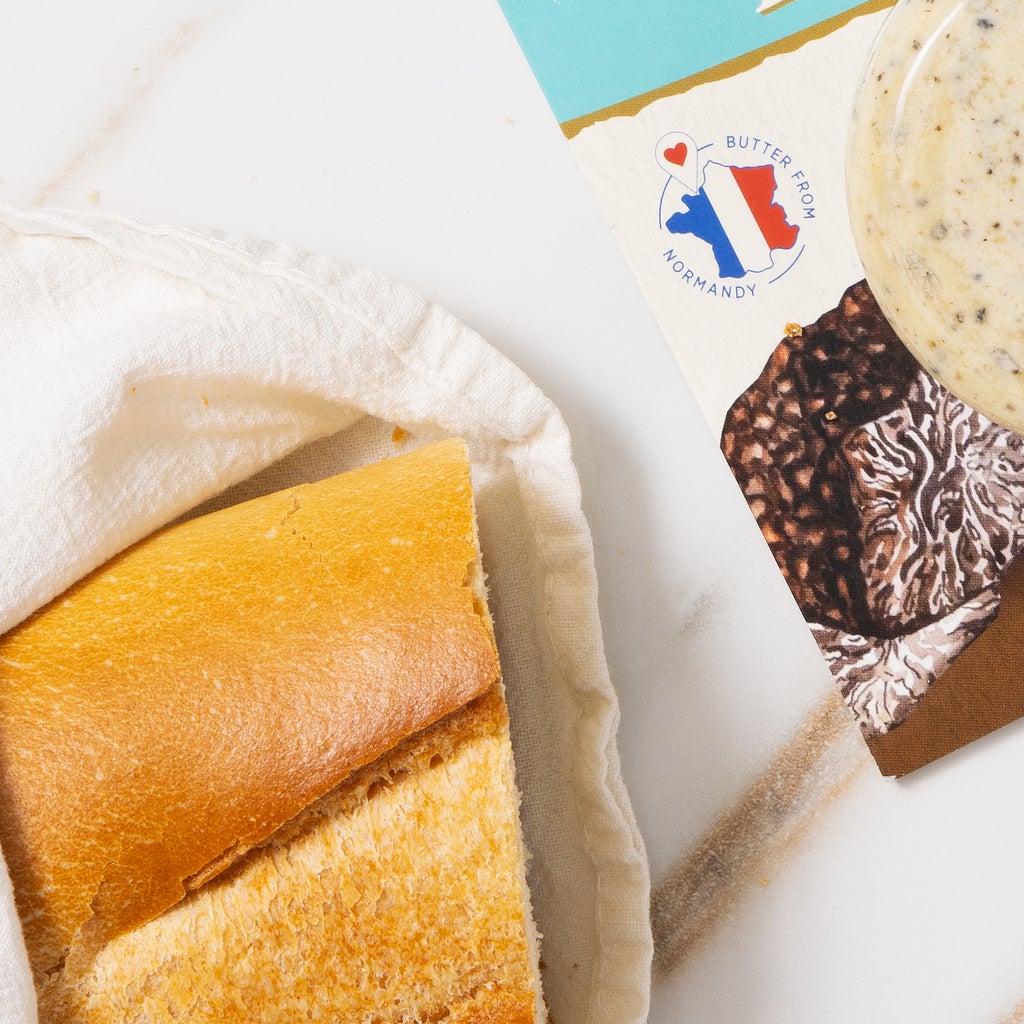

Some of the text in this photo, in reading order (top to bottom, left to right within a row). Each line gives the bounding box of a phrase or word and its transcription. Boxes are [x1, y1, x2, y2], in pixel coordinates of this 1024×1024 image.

[727, 135, 816, 219] BUTTER FROM
[663, 249, 756, 298] NORMANDY
